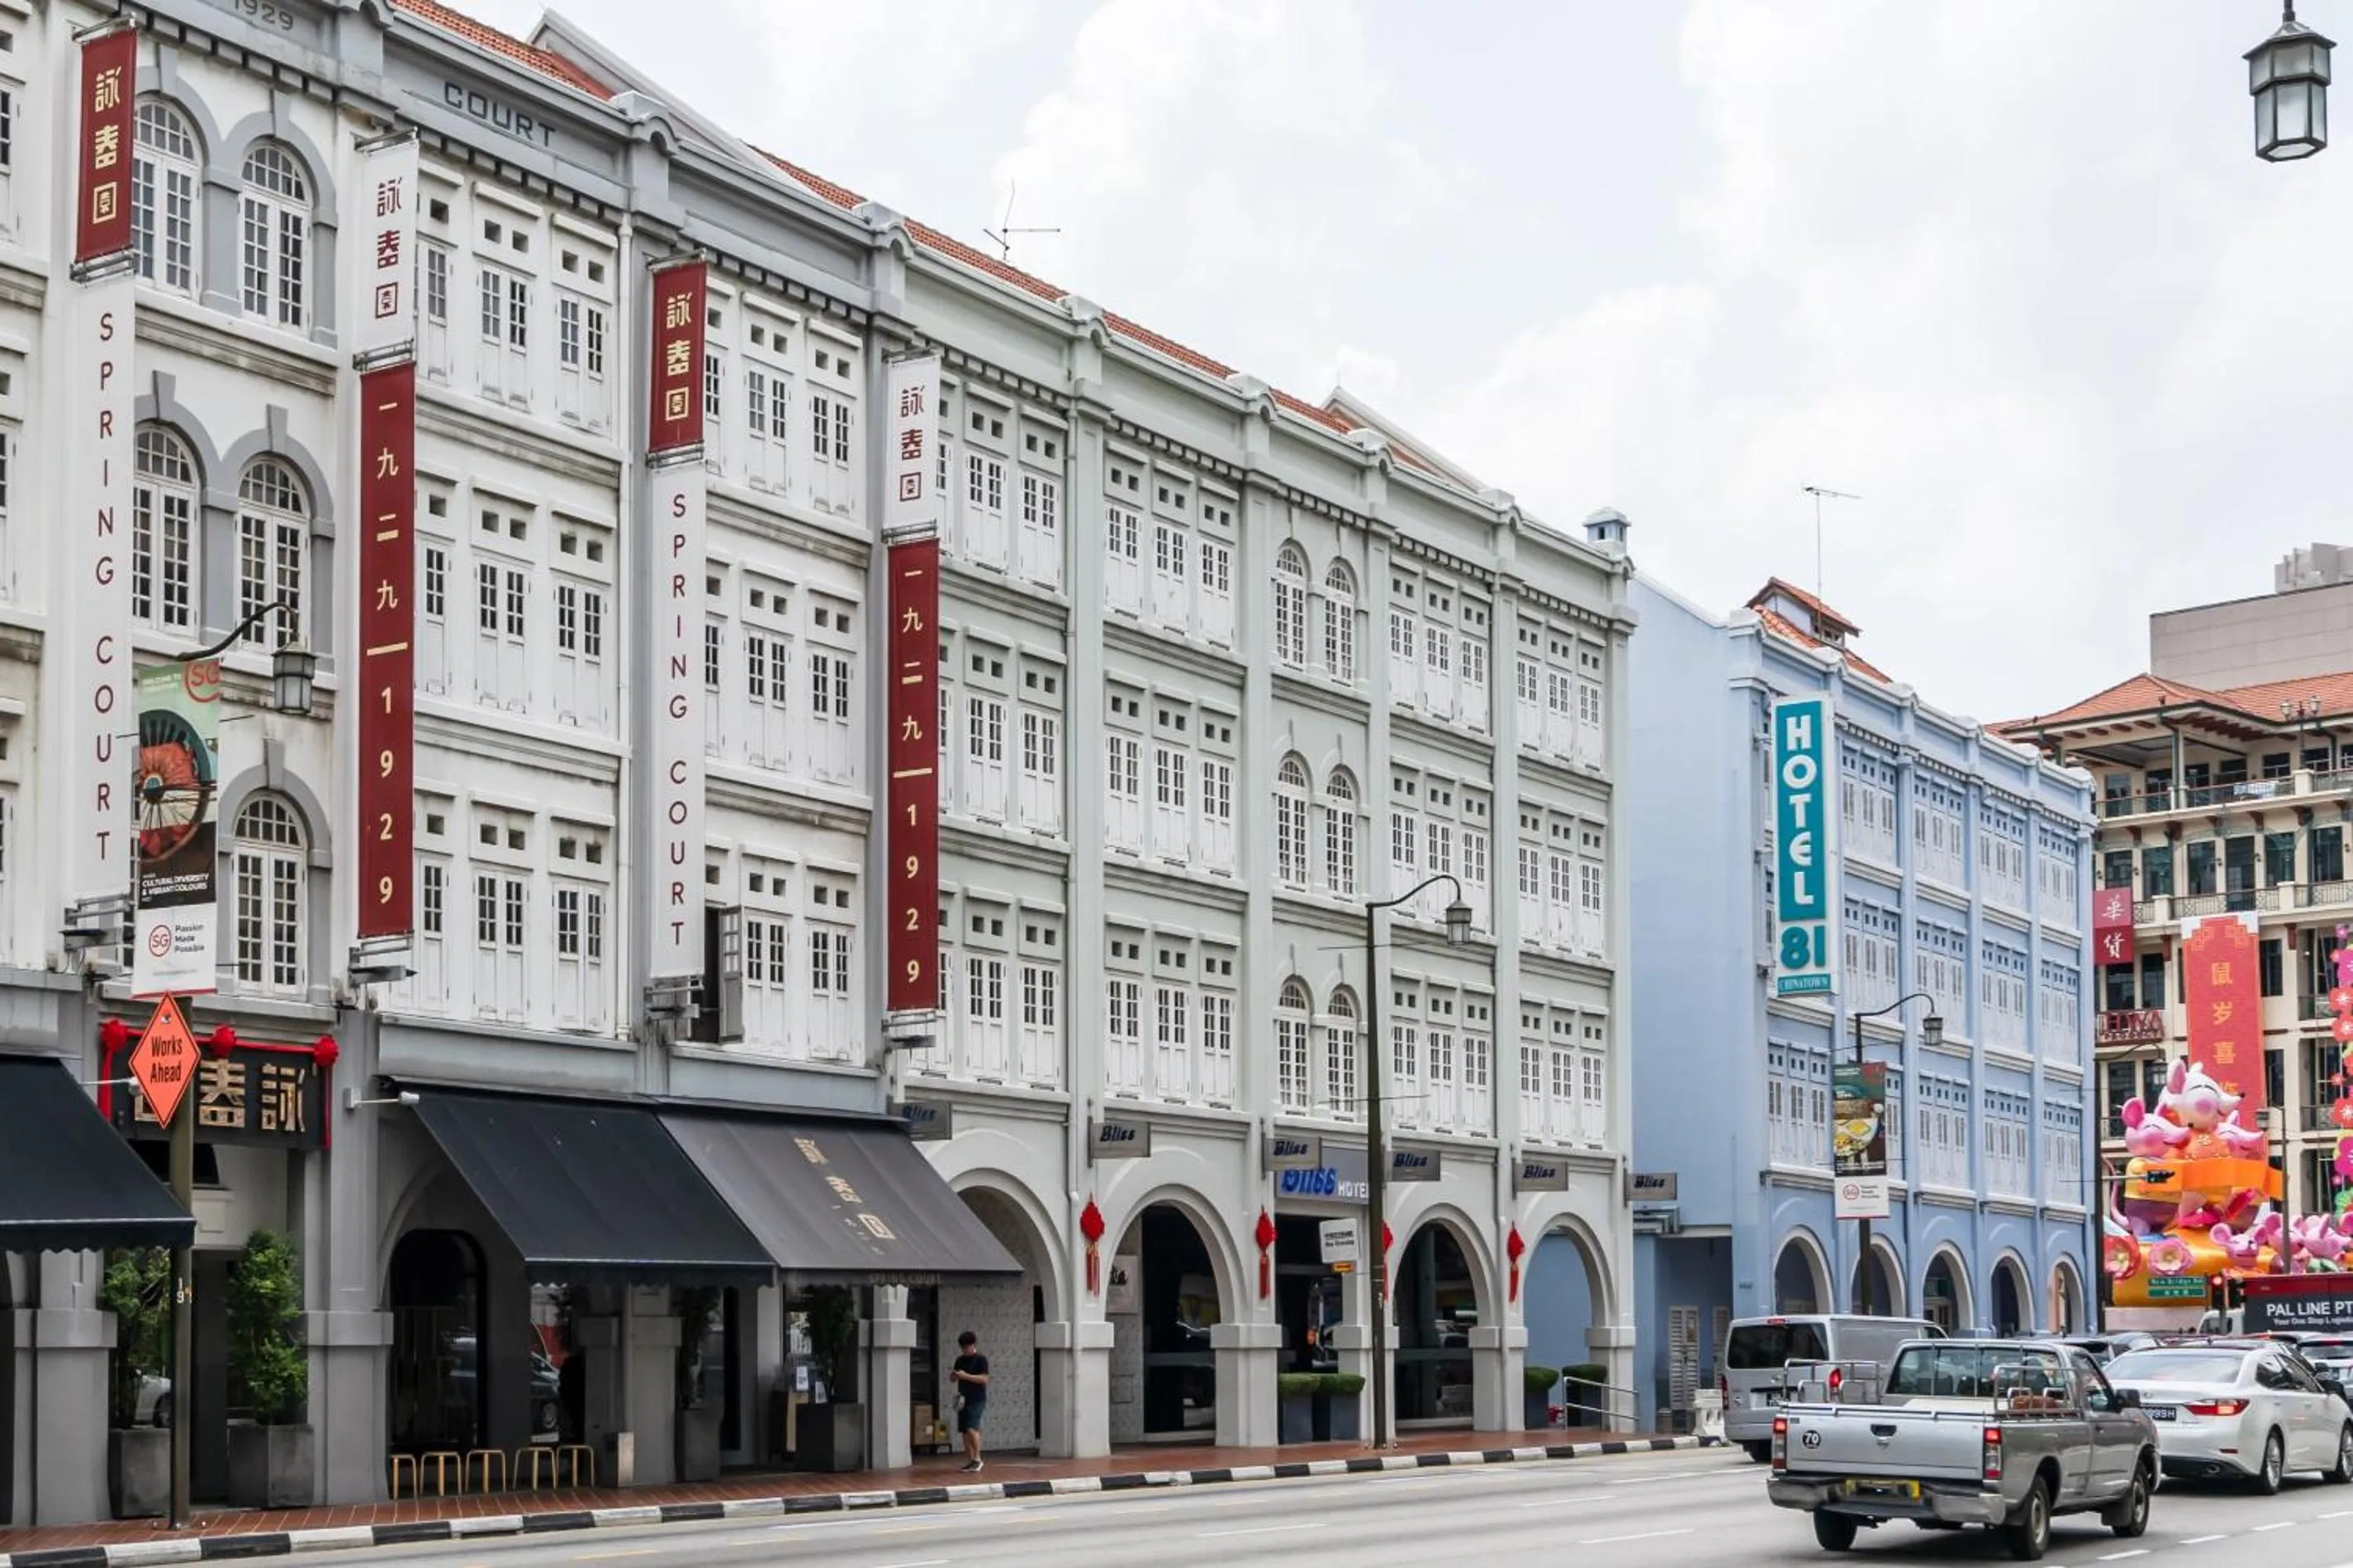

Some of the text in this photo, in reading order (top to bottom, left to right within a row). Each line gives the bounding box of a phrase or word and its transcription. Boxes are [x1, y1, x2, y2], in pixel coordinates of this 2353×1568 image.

[444, 82, 556, 148] COURT
[94, 312, 114, 861] SPRING COURT
[668, 493, 688, 947] SPRING COURT
[1783, 714, 1817, 905] HOTEL
[1780, 925, 1826, 969] 81
[151, 1036, 183, 1057] Works
[149, 1062, 182, 1083] Ahead
[1100, 1125, 1136, 1142] Bliss
[1274, 1141, 1308, 1155] Bliss
[1393, 1153, 1428, 1168] Bliss
[1523, 1165, 1556, 1179] Bliss
[1634, 1174, 1666, 1188] Bliss
[2266, 1300, 2353, 1316] PAL LINE PT
[1805, 1433, 1819, 1443] 70
